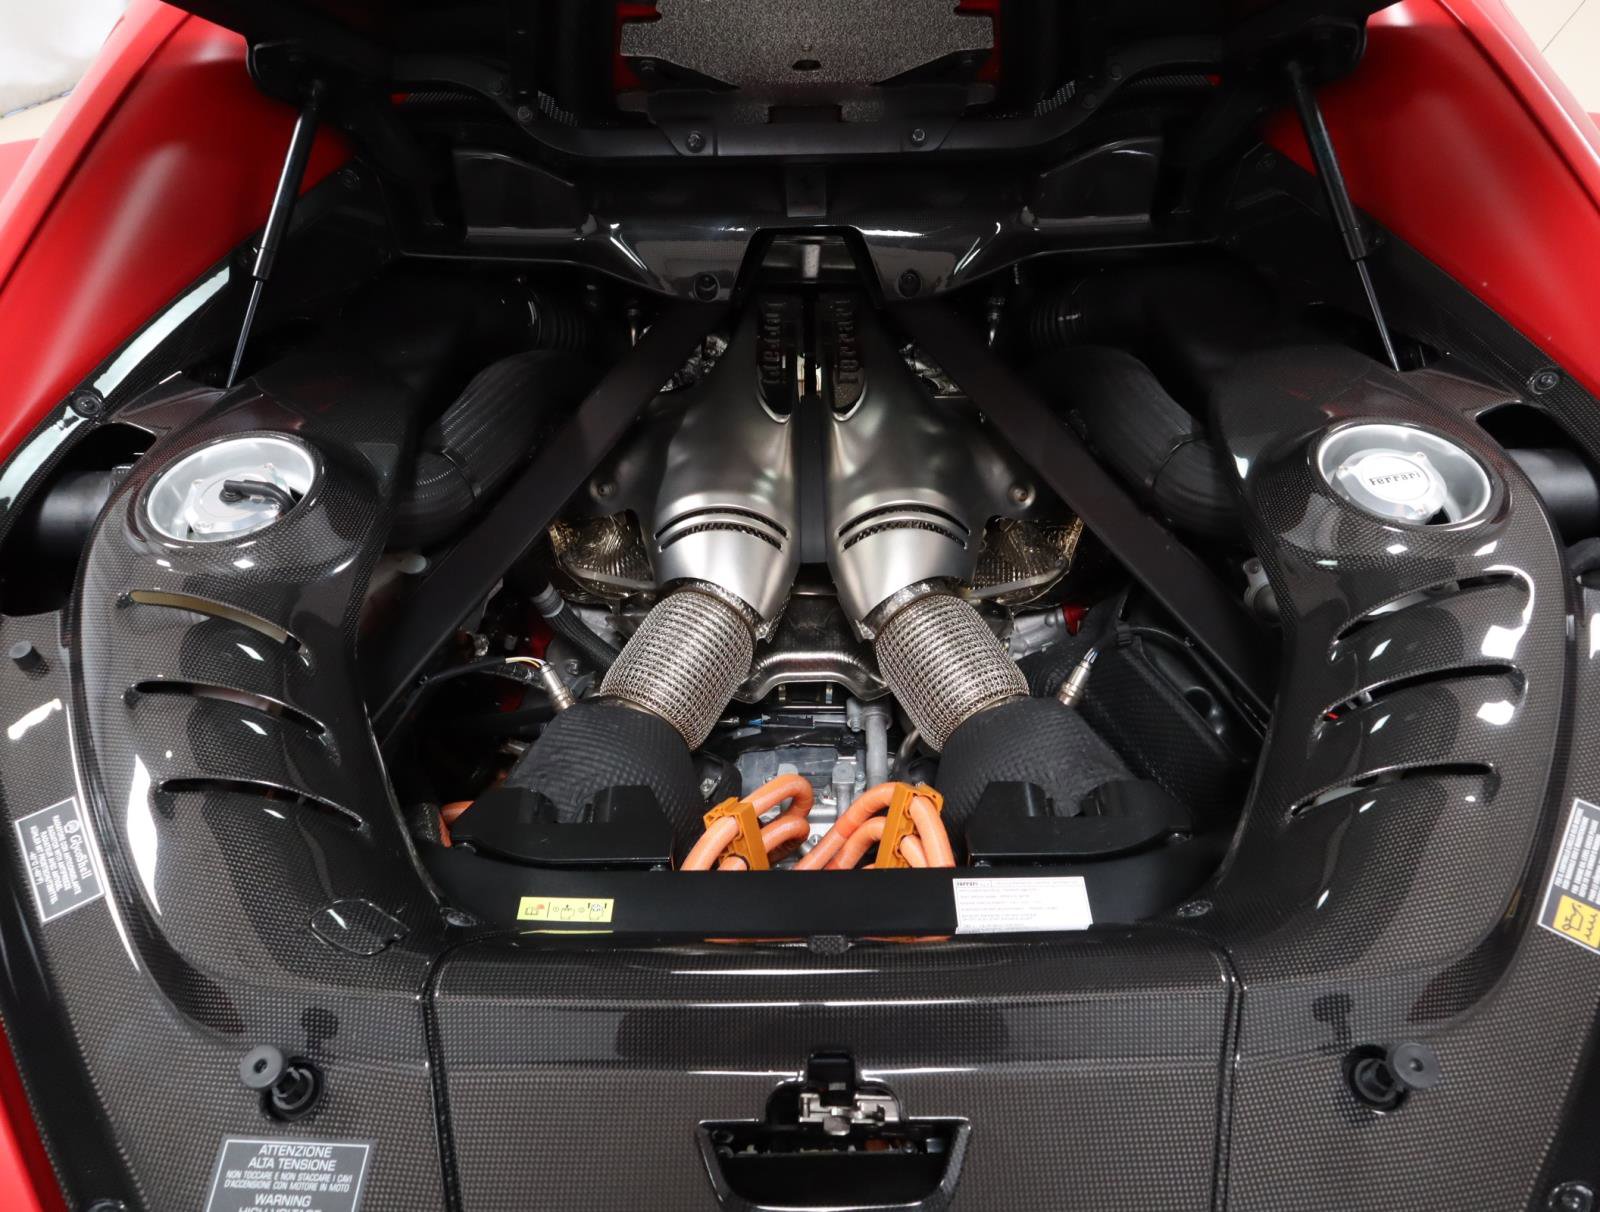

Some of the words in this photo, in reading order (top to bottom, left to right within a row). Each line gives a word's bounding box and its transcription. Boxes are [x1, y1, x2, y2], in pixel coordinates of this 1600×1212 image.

[1369, 471, 1421, 486] Ferrari
[70, 834, 93, 880] GlycoShell
[258, 1144, 333, 1158] ATTENZIONE
[248, 1157, 274, 1169] ALTA
[279, 1157, 337, 1171] TENSIONE
[226, 1170, 242, 1179] NON
[280, 1172, 297, 1181] NON
[297, 1172, 332, 1182] STACCARE
[337, 1174, 353, 1183] CAVI
[272, 1181, 288, 1190] CON
[289, 1181, 318, 1191] MOTORE
[328, 1183, 350, 1192] MOTO
[255, 1193, 312, 1207] WARNING
